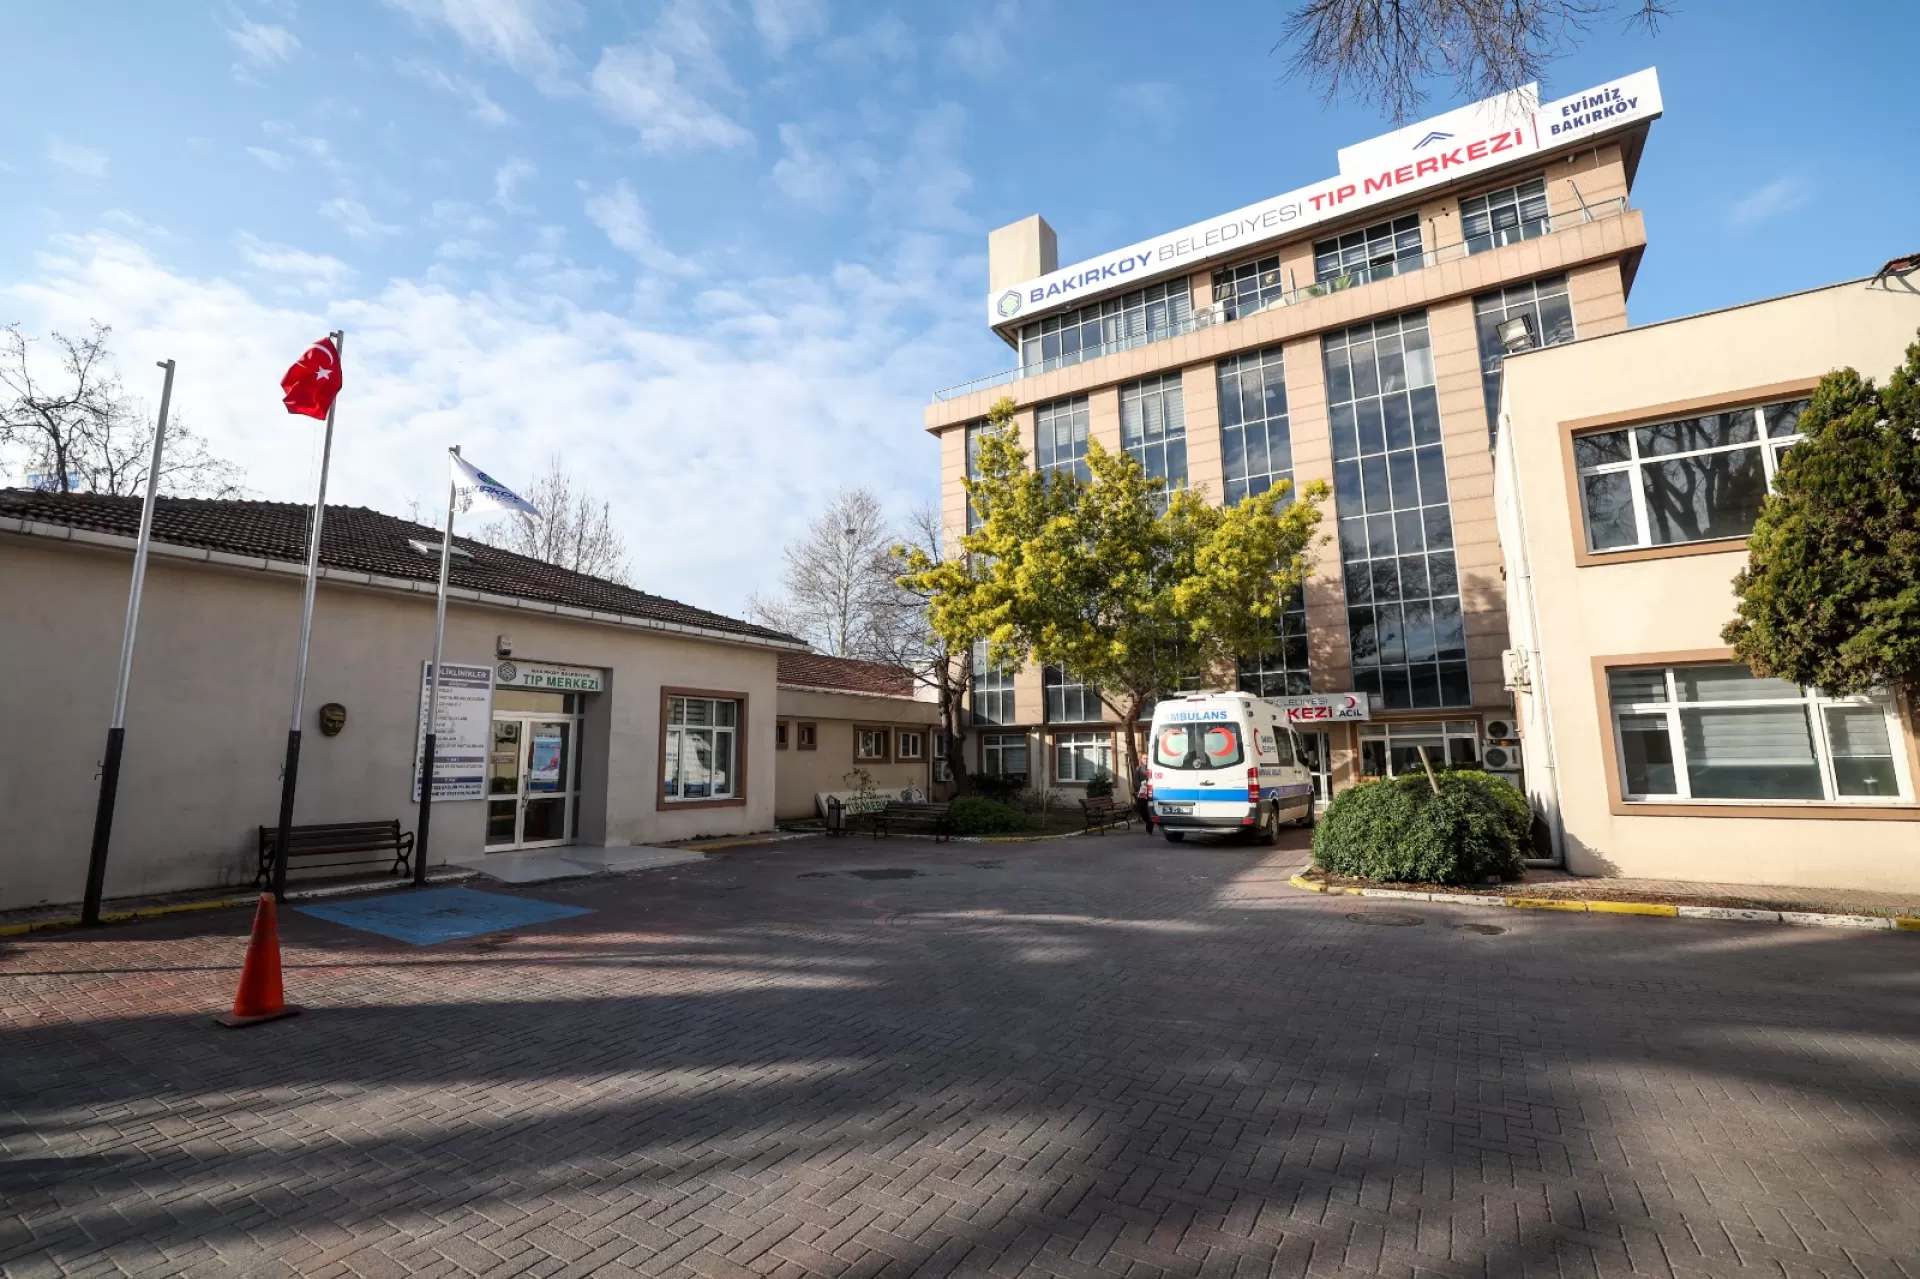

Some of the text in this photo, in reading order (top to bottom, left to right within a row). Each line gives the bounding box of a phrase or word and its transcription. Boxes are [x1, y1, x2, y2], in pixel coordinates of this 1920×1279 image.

[1562, 88, 1621, 117] EVİMİZ
[1551, 97, 1639, 135] BAKIRKÖY
[1308, 184, 1356, 211] TIP
[1363, 128, 1523, 195] MERKEZİ
[523, 674, 599, 691] TIP MERKEZİ
[1166, 710, 1228, 722] MBULANS
[1287, 706, 1333, 719] KEZİ
